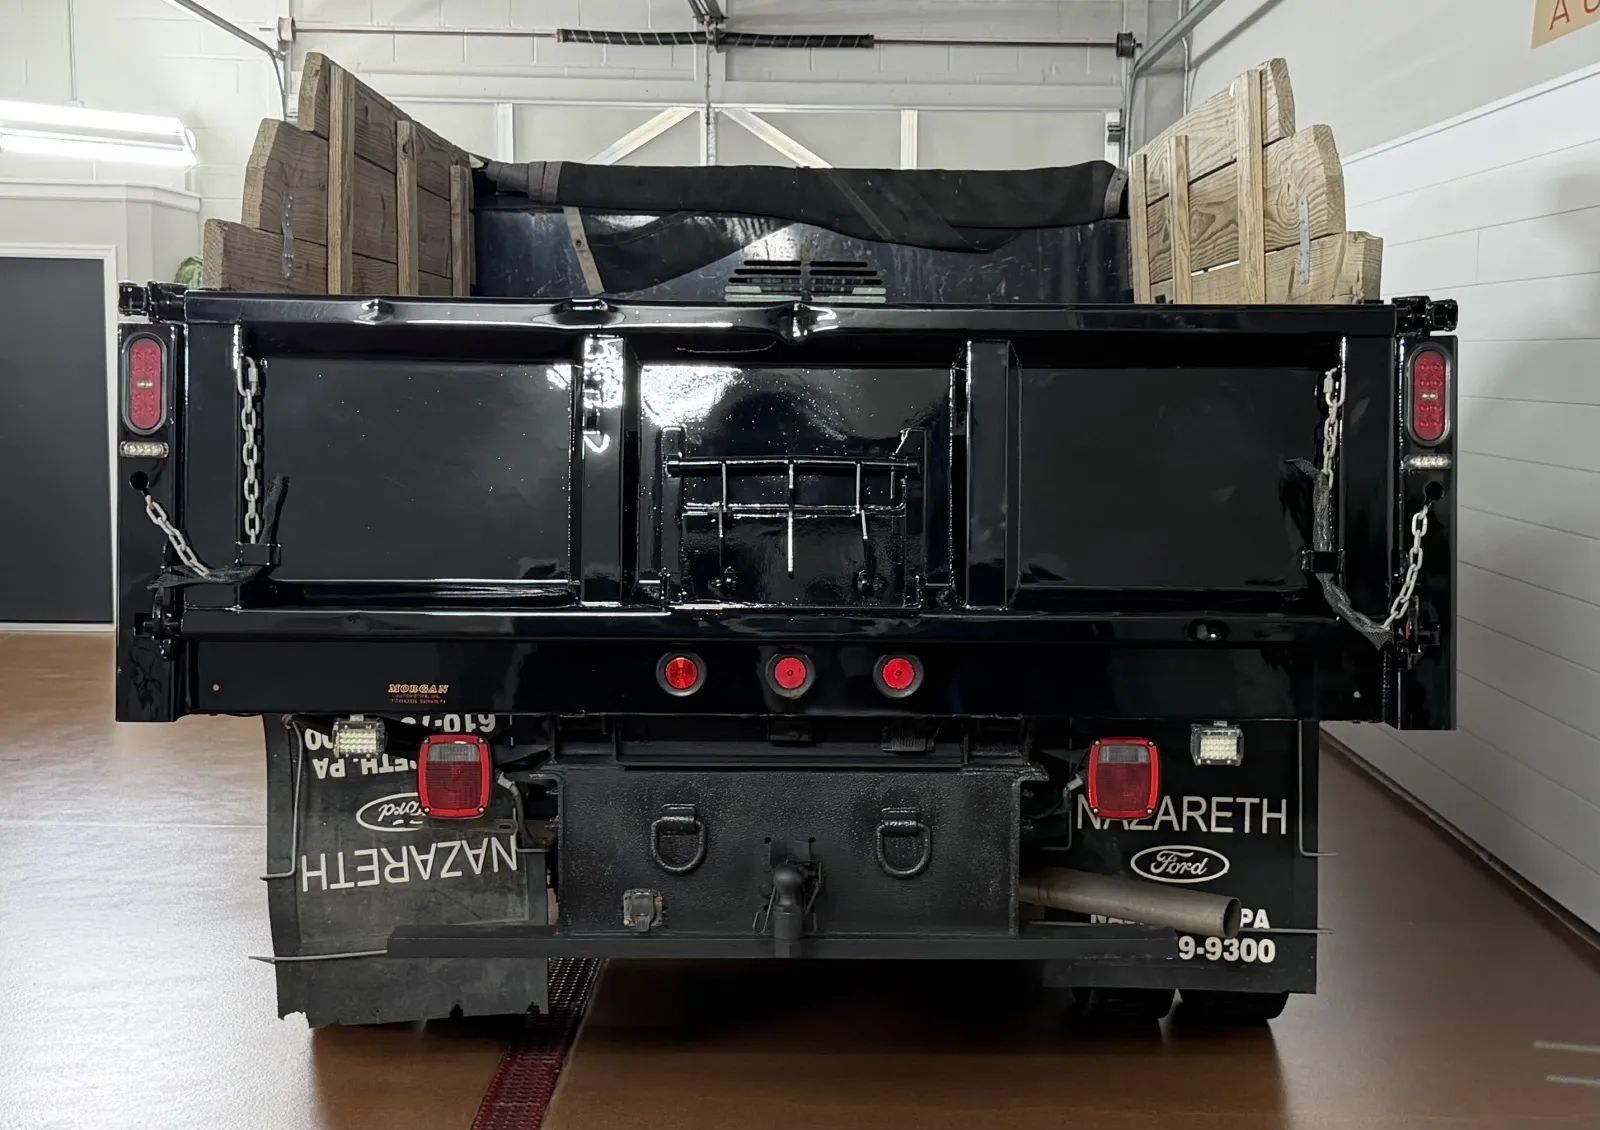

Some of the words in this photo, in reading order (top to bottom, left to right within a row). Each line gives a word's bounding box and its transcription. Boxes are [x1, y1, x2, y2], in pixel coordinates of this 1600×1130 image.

[388, 683, 449, 694] MORGAN
[312, 758, 346, 779] PA
[302, 836, 518, 892] NAZARETH
[1150, 850, 1209, 875] Ford
[1240, 908, 1271, 929] PA
